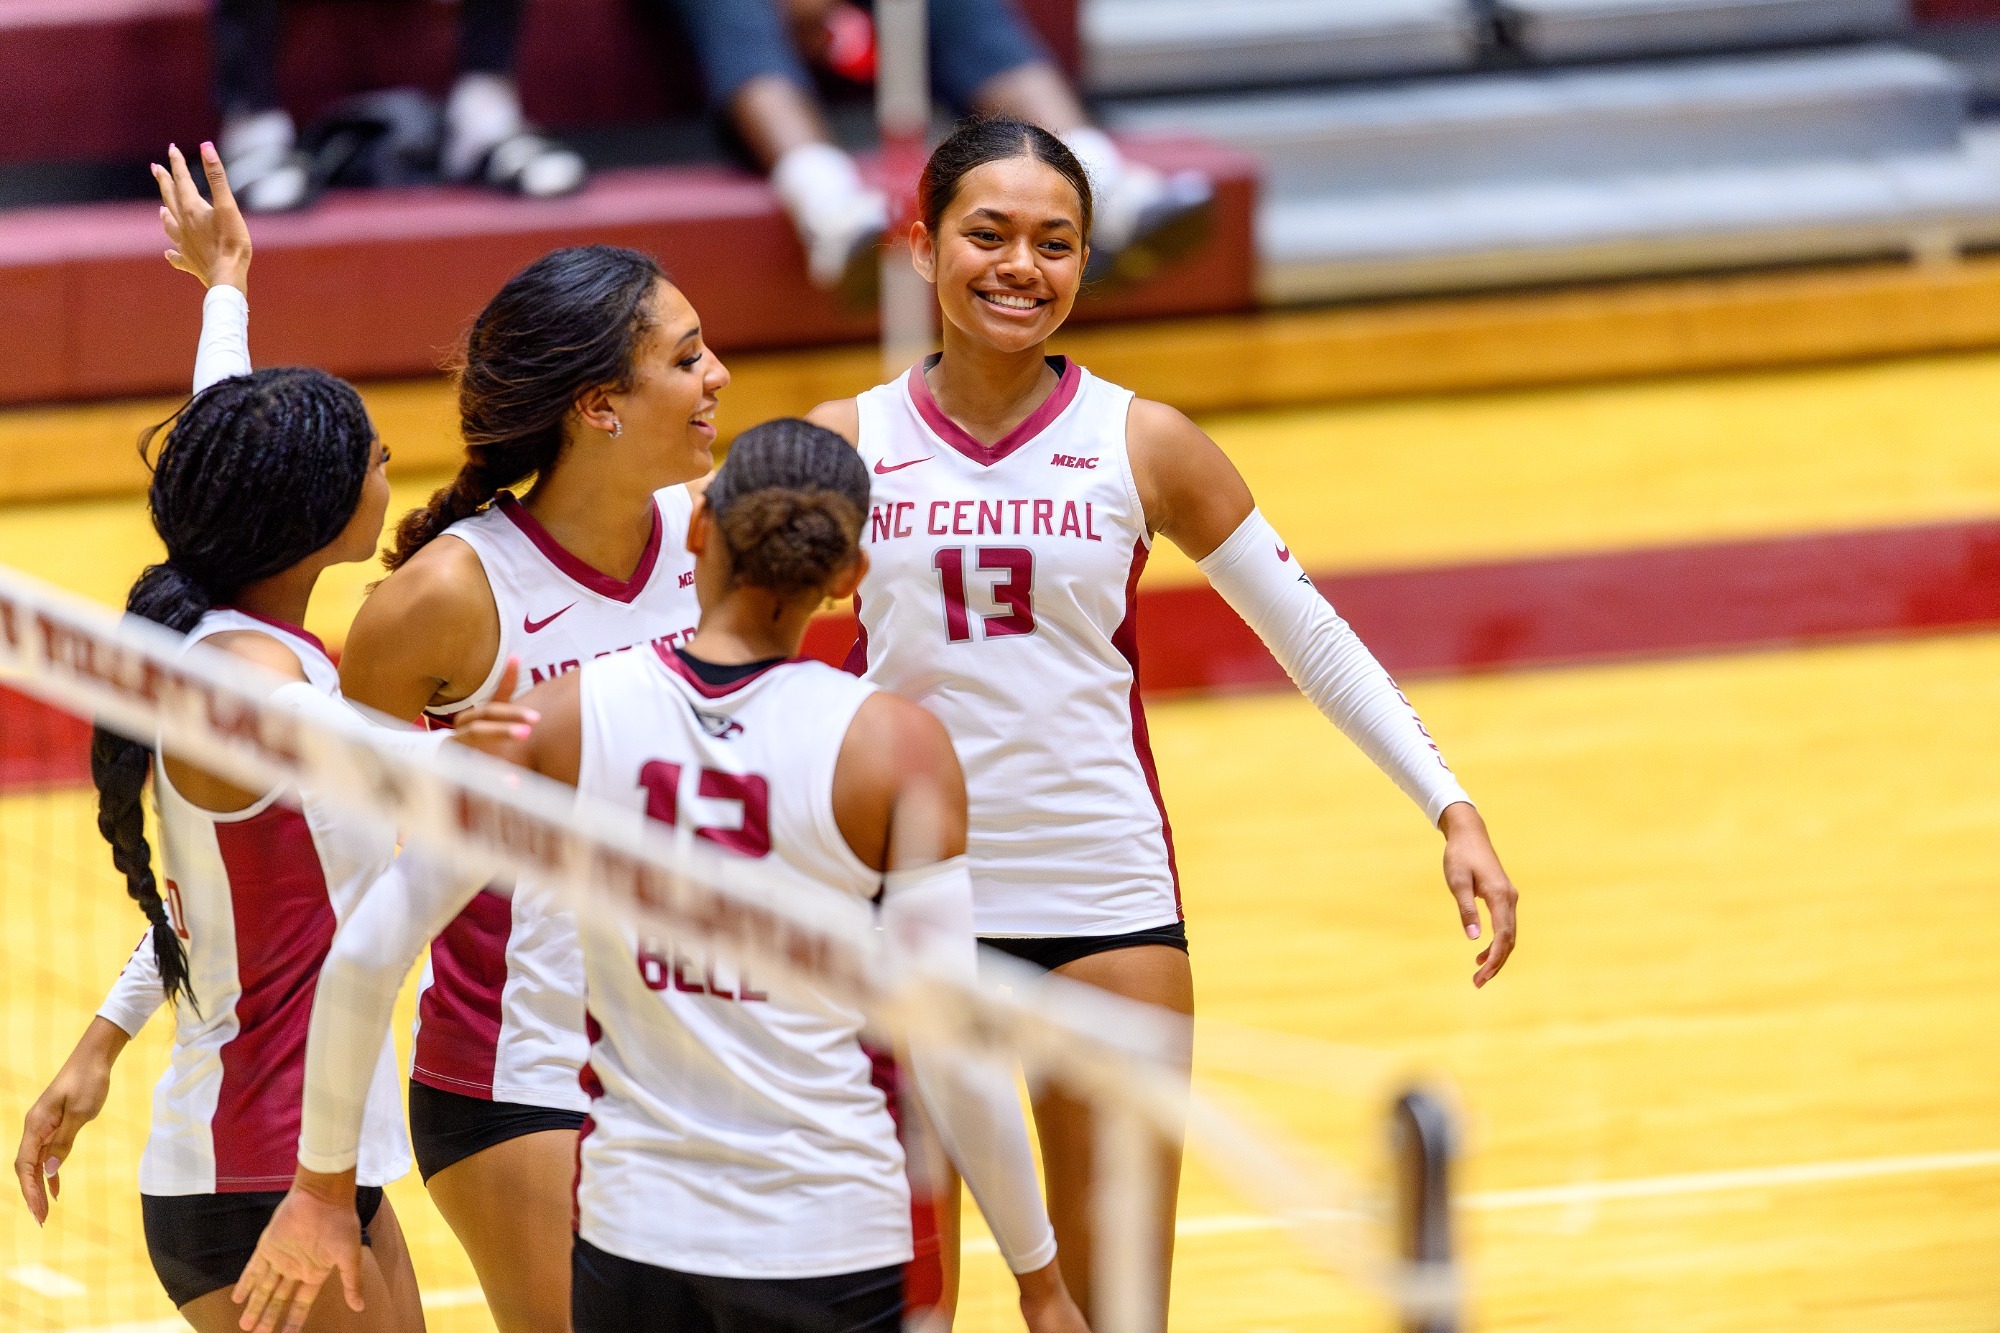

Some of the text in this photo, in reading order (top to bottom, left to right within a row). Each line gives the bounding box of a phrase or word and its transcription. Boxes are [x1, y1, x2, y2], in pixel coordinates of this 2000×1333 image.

[1050, 453, 1099, 470] MEAC
[871, 499, 1102, 543] NC CENTRAL
[678, 571, 696, 589] ME
[931, 545, 1038, 645] 13
